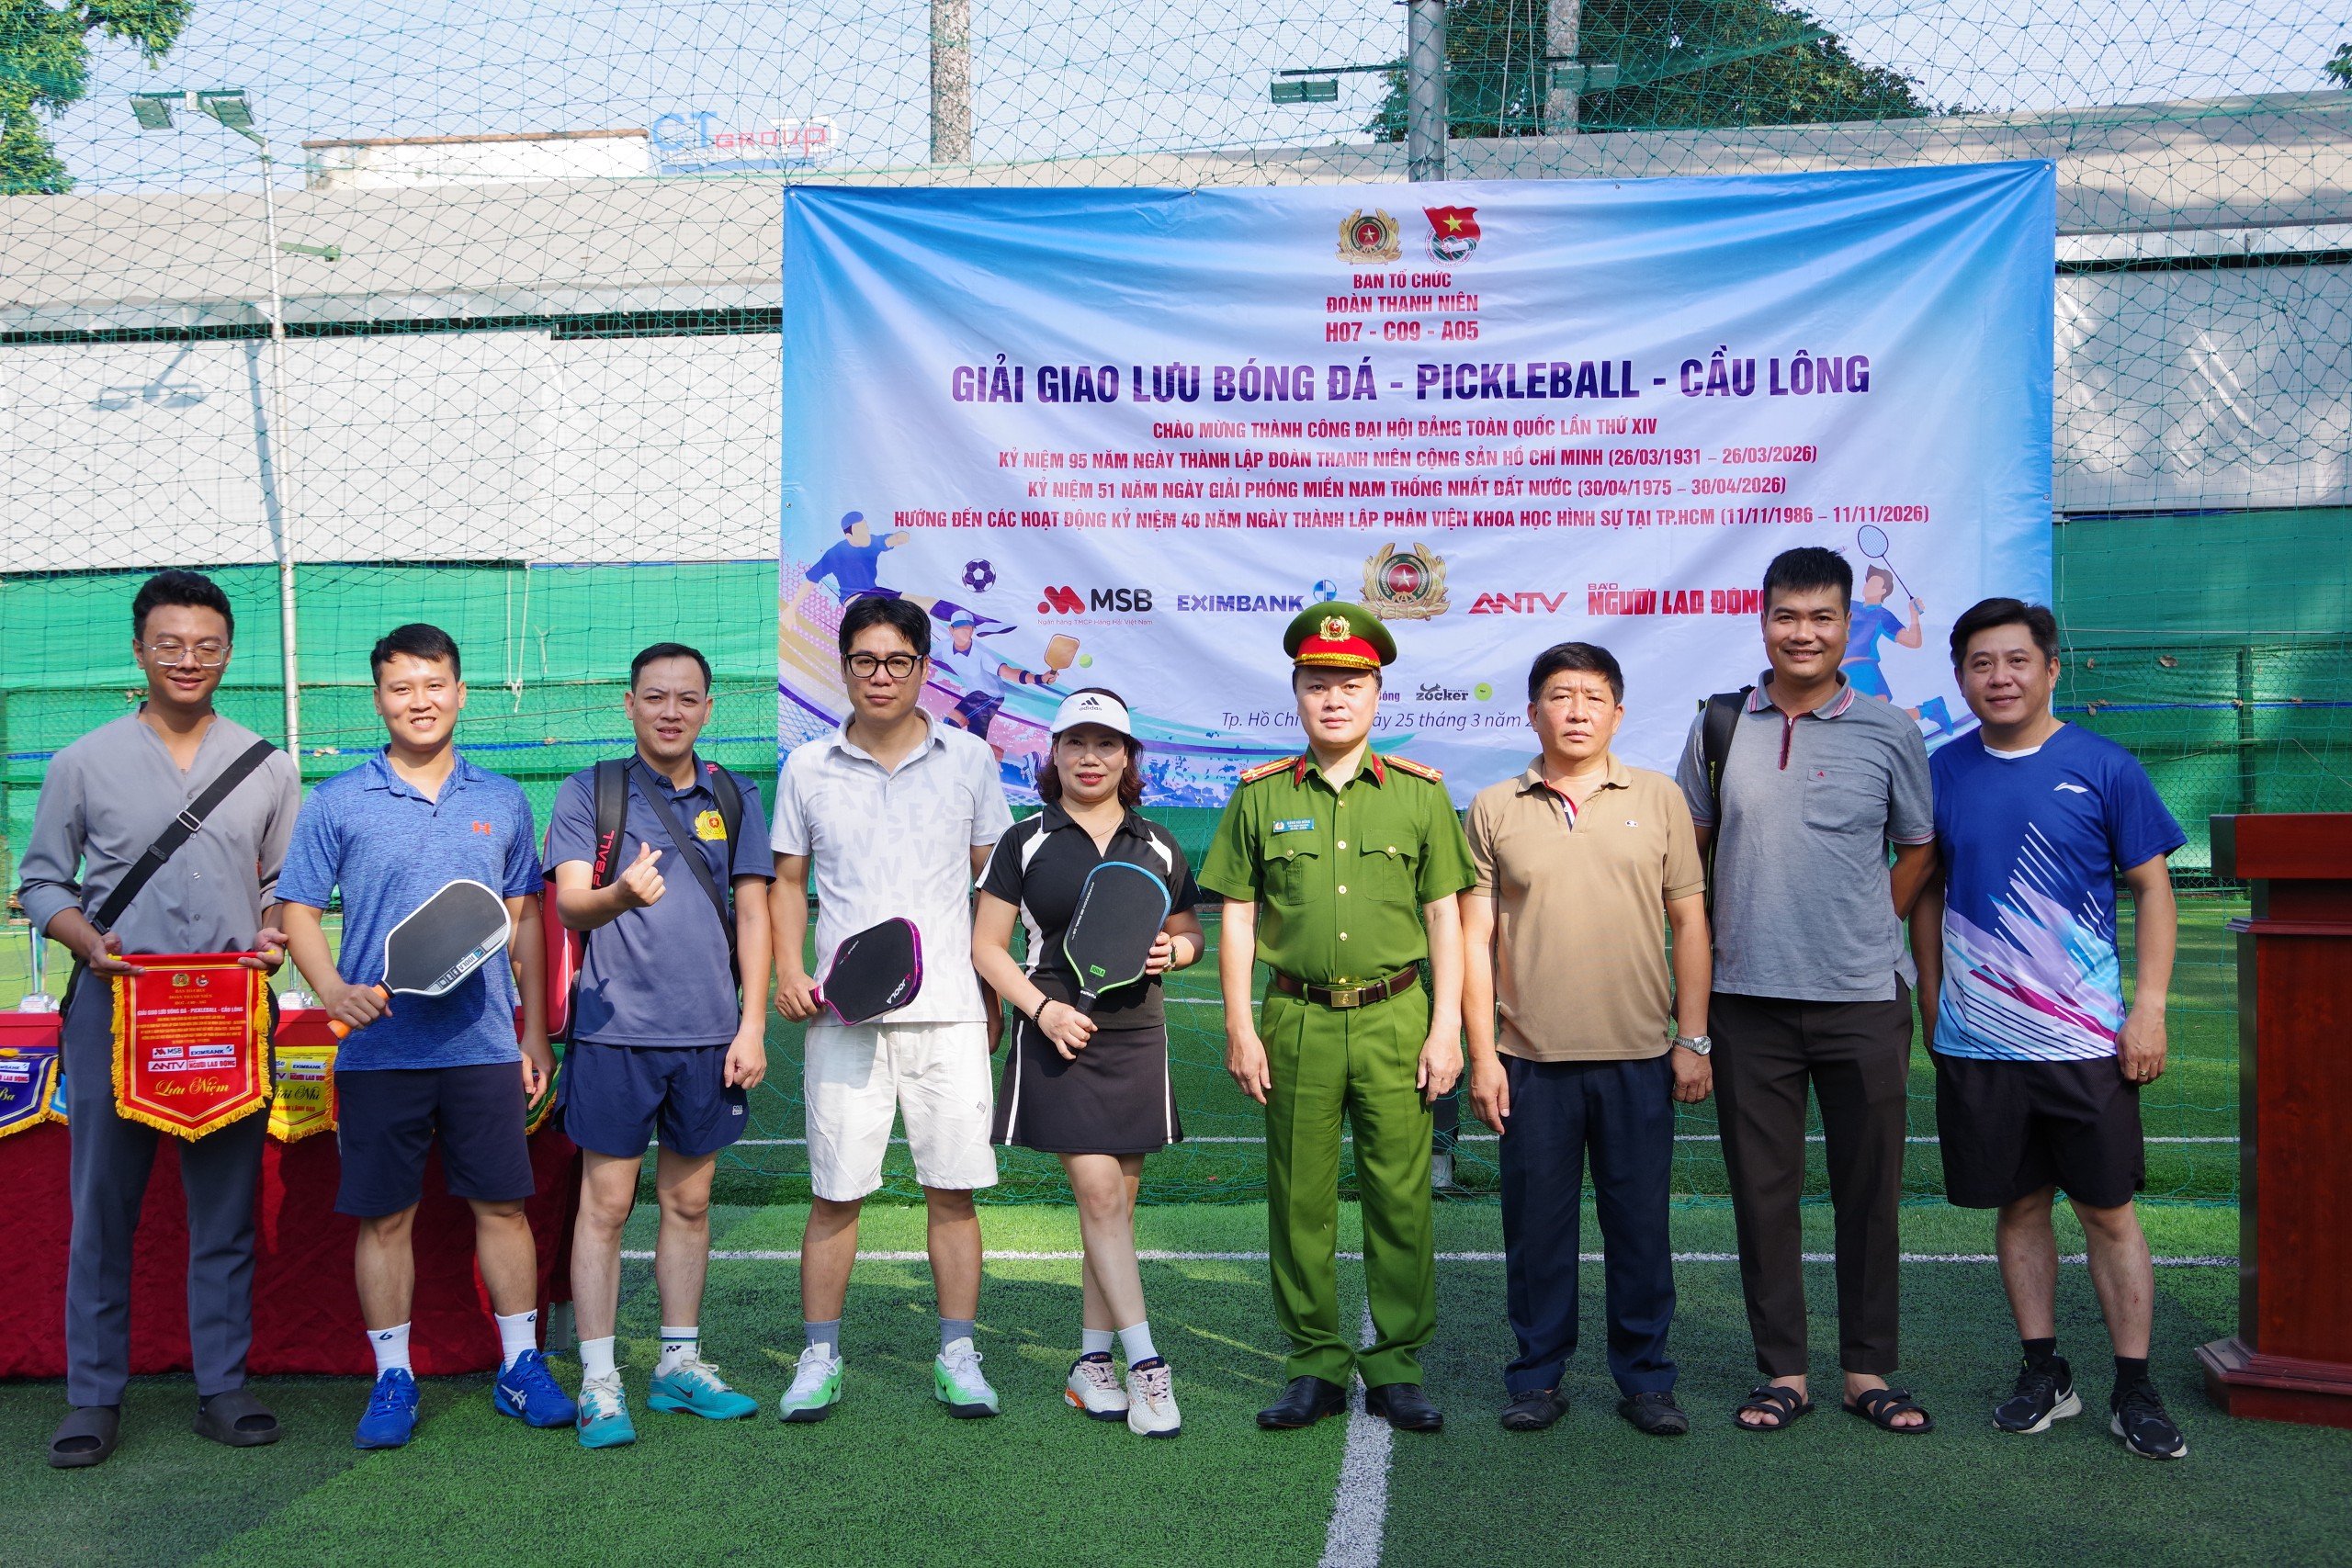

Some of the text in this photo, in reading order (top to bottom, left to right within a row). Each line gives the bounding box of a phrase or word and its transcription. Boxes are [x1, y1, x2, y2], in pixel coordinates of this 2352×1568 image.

[652, 111, 718, 151] CT
[1353, 269, 1452, 289] BAN TỔ CHỨC
[1326, 291, 1478, 313] ĐOÀN THANH NIÊN
[1326, 321, 1363, 342] H07
[1383, 321, 1421, 342] C09
[1441, 321, 1479, 341] A05
[952, 353, 1024, 403] GIẢI
[1036, 365, 1120, 405] GIAO
[1132, 361, 1201, 403] LƯU
[1213, 357, 1315, 403] BÓNG
[1326, 355, 1378, 401] ĐÁ
[1416, 360, 1640, 400] PICKLEBALL
[1679, 344, 1756, 398] CẦU
[1769, 348, 1870, 397] LÔNG
[1152, 413, 1658, 442] CHÀO MỪNG THÀNH CÔNG ĐẠI HỘI ĐẢNG TOÀN QUỐC LẦN THỨ XIV
[999, 446, 1019, 468] KỶ
[1023, 449, 1064, 472] NIỆM
[1069, 453, 1088, 469] 95
[1091, 448, 1128, 469] NĂM
[1133, 448, 1175, 469] NGÀY
[1179, 447, 1230, 469] THÀNH
[1234, 448, 1264, 472] LẬP
[1268, 448, 1312, 468] ĐOÀN
[1316, 451, 1369, 468] THANH
[1373, 447, 1412, 468] NIÊN
[1416, 446, 1460, 470] CỘNG
[1464, 445, 1498, 467] SẢN
[1502, 445, 1524, 467] HỒ
[1529, 446, 1555, 467] CHÍ
[1560, 448, 1603, 466] MINH
[1608, 448, 1701, 468] (26/03/1931
[1722, 445, 1817, 465] 26/03/2026)
[1028, 476, 1048, 498] KỶ
[1052, 479, 1093, 502] NIỆM
[1097, 482, 1114, 499] 51
[1121, 479, 1158, 499] NĂM
[1162, 479, 1204, 499] NGÀY
[1208, 476, 1240, 499] GIẢI
[1245, 478, 1298, 499] PHÓNG
[1303, 475, 1344, 498] MIỀN
[1348, 480, 1386, 498] NAM
[1390, 474, 1443, 498] THỐNG
[1447, 474, 1489, 497] NHẤT
[1493, 476, 1525, 498] ĐẤT
[1528, 474, 1573, 497] NƯỚC
[1577, 479, 1672, 498] (30/04/1975
[1690, 476, 1787, 496] 30/04/2026)
[894, 507, 947, 529] HƯỚNG
[951, 506, 983, 528] ĐẾN
[987, 507, 1017, 528] CÁC
[1021, 510, 1060, 533] HOẠT
[1063, 508, 1107, 532] ĐỘNG
[1111, 506, 1132, 528] KỶ
[1136, 507, 1177, 532] NIỆM
[1181, 510, 1201, 529] 40
[1204, 508, 1242, 529] NĂM
[1246, 508, 1289, 529] NGÀY
[1292, 508, 1345, 529] THÀNH
[1349, 507, 1379, 531] LẬP
[1384, 507, 1428, 528] PHÂN
[1431, 505, 1468, 531] VIỆN
[1471, 509, 1516, 528] KHOA
[1520, 510, 1552, 531] HỌC
[1556, 506, 1596, 527] HÌNH
[1600, 507, 1624, 530] SỰ
[1626, 509, 1652, 530] TẠI
[1656, 508, 1715, 526] TP.HCM
[1720, 505, 1814, 526] (11/11/1986
[1833, 504, 1929, 525] 11/11/2026)
[1091, 588, 1152, 613] MSB
[1177, 594, 1306, 613] EXIMBANK
[1468, 592, 1567, 615] ANTV
[1588, 589, 1657, 615] NGƯỜI
[1662, 590, 1704, 615] LAO
[1379, 690, 1400, 703] óng
[1222, 712, 1242, 730] Tp.
[1249, 710, 1270, 727] Hồ
[1373, 712, 1393, 731] ày
[1395, 713, 1414, 728] 25
[1419, 711, 1467, 731] tháng
[1471, 713, 1481, 728] 3
[1485, 711, 1521, 728] năm
[459, 955, 476, 971] JOOLA
[887, 978, 906, 1005] JOOLA
[152, 1061, 185, 1070] ANTV
[153, 1077, 230, 1096] Lưu Niệm
